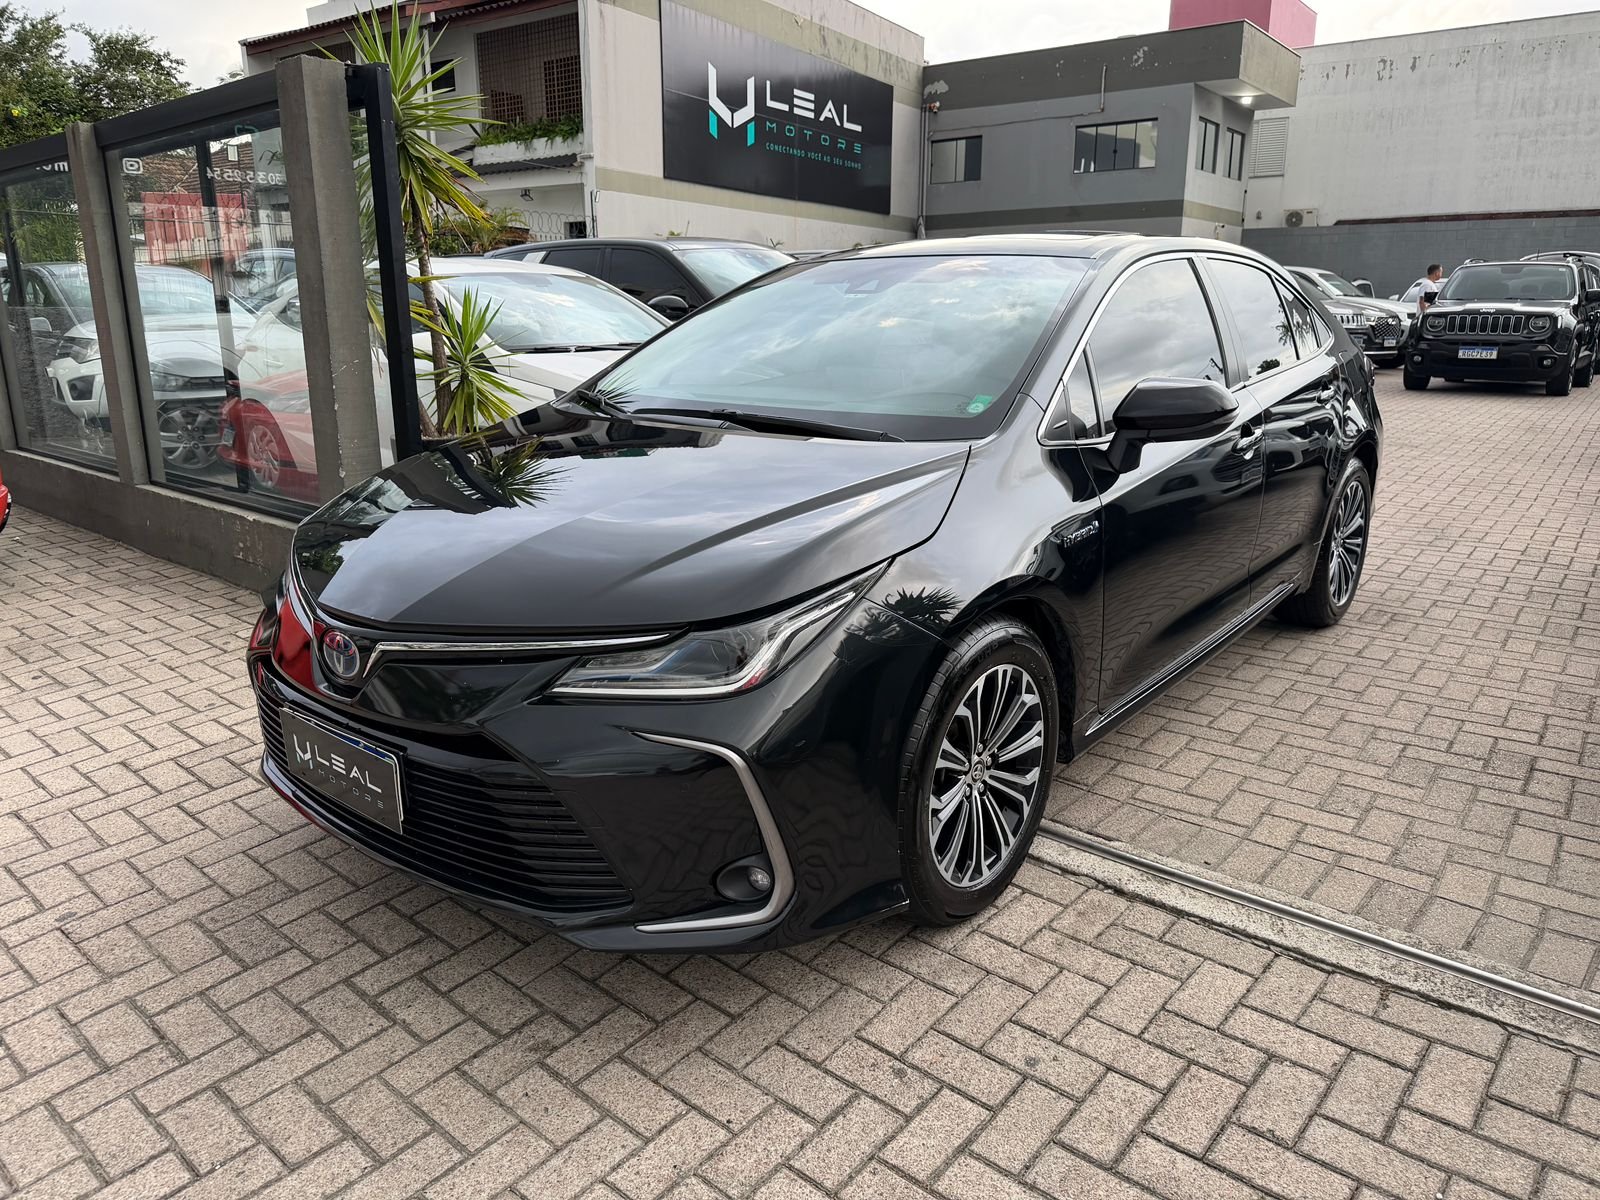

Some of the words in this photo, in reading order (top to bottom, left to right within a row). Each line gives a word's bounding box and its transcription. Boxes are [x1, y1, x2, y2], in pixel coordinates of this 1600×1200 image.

[766, 80, 862, 132] LEAL
[766, 142, 805, 158] CONECTANDO
[315, 744, 382, 793] LEAL
